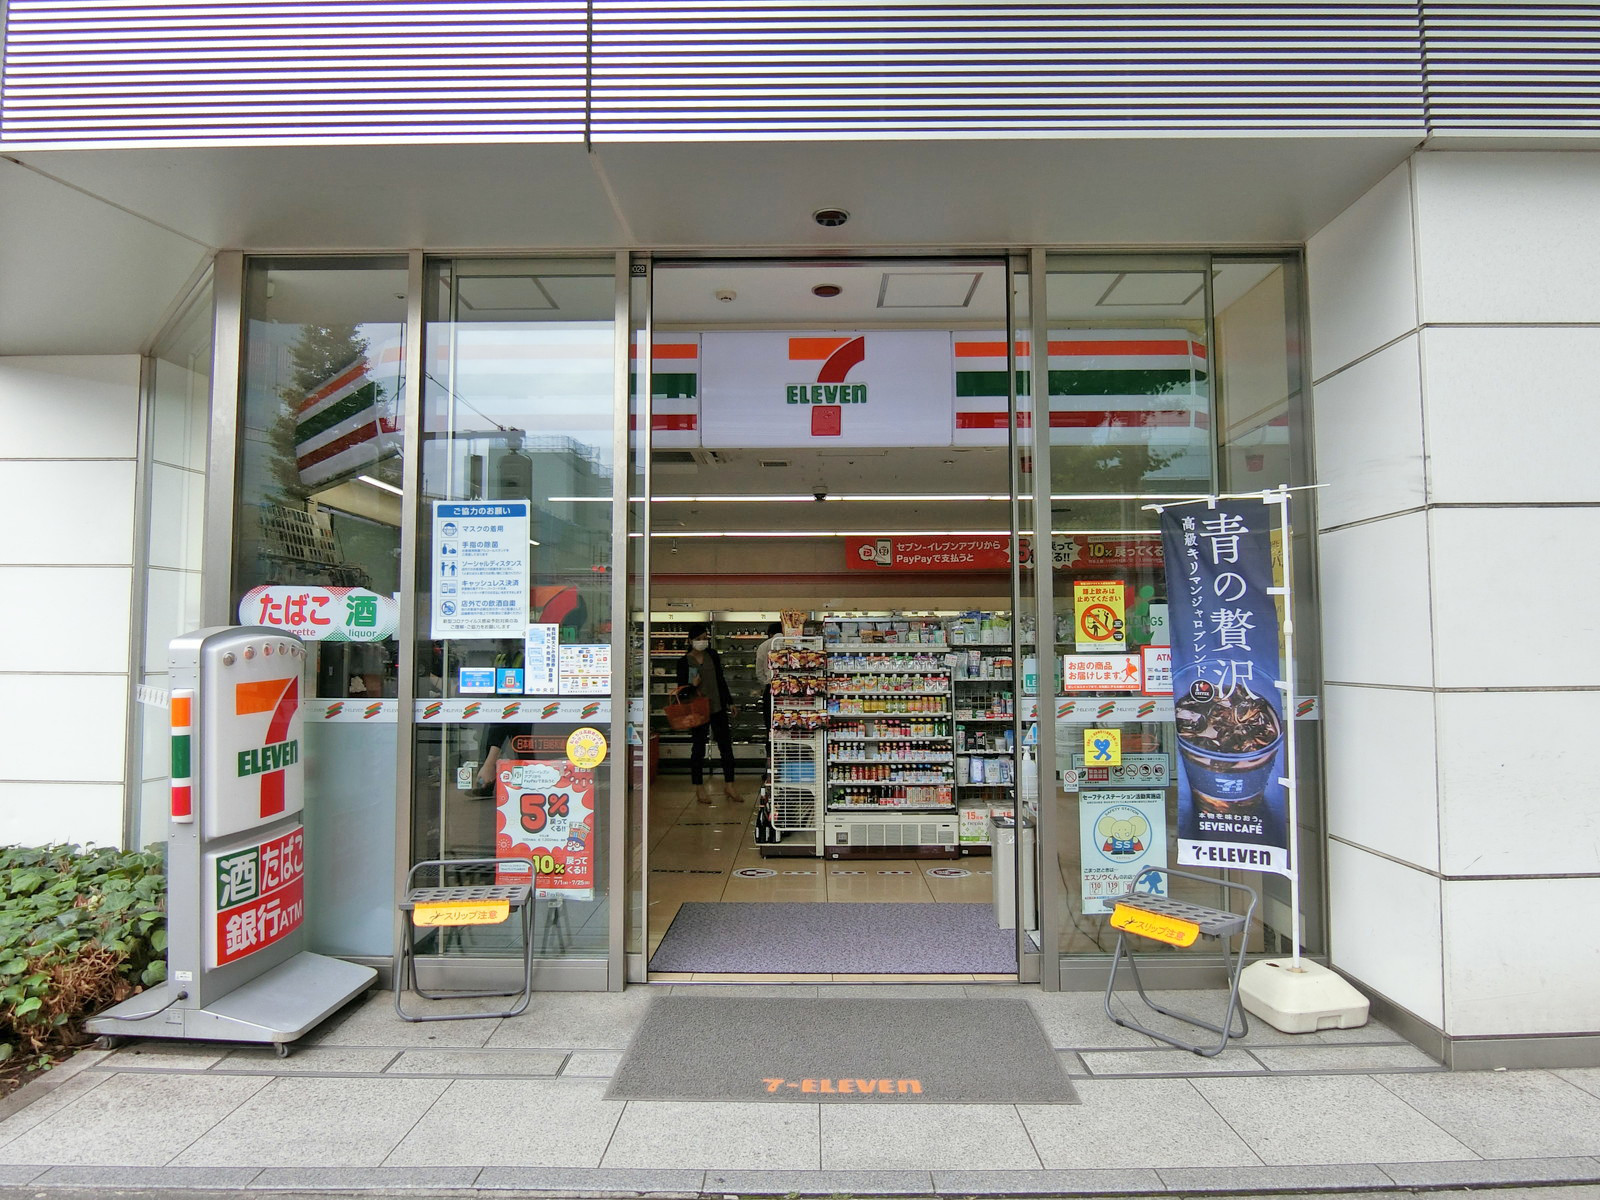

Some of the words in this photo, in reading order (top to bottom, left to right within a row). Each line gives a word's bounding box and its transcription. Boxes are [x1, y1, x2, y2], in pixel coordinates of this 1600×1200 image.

[789, 336, 865, 436] 7
[454, 507, 510, 516] ご協力のお願い
[896, 541, 1001, 551] セブン-イレブンアプリから
[896, 554, 974, 564] PayPayで支払うと
[1181, 516, 1206, 678] 高級キリマンジャロブレンド
[259, 593, 331, 626] たばこ
[346, 596, 378, 627] 酒
[1199, 513, 1259, 700] 青の贅沢
[349, 630, 376, 638] liquor
[1068, 662, 1112, 670] お店の商品
[1068, 672, 1122, 680] お届けします。
[236, 675, 298, 819] 7
[1105, 807, 1120, 816] SAFETY
[1122, 807, 1140, 816] STATION
[1198, 812, 1262, 823] 本物を味わおう。
[1200, 821, 1234, 832] SEVEN
[1234, 821, 1262, 834] CAFÉ
[1115, 840, 1130, 848] SS
[262, 835, 304, 891] たばこ
[566, 856, 588, 865] 戻って
[566, 866, 587, 874] くる!!
[220, 851, 258, 907] 酒
[444, 910, 498, 920] スリップ注意
[1136, 921, 1186, 942] スリップ注意
